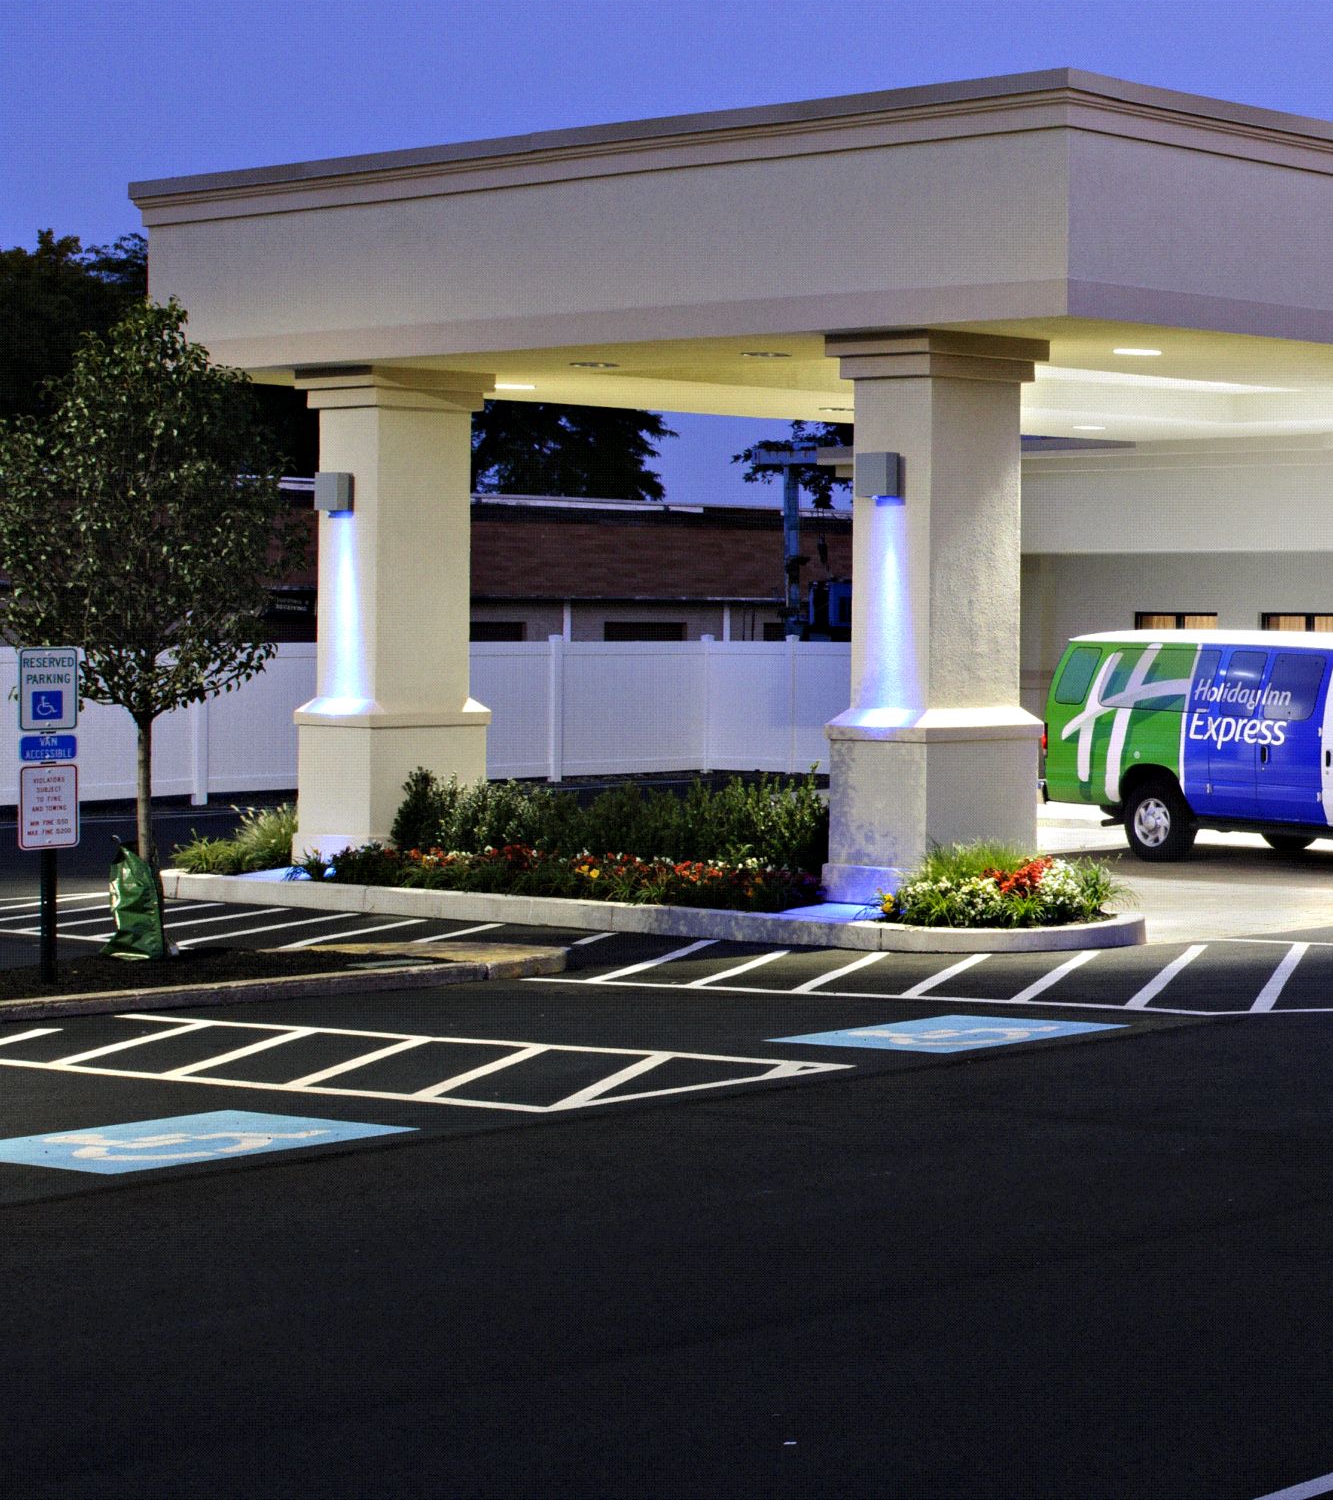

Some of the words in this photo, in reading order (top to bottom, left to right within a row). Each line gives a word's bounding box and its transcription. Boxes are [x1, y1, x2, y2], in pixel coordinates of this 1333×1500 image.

[23, 656, 75, 668] RESERVED
[26, 673, 71, 685] PARKING
[1193, 678, 1262, 710] Holiday
[1261, 682, 1292, 706] Inn
[1189, 707, 1288, 750] Express
[39, 736, 58, 747] VAN
[25, 749, 73, 759] ACCESSIBLE
